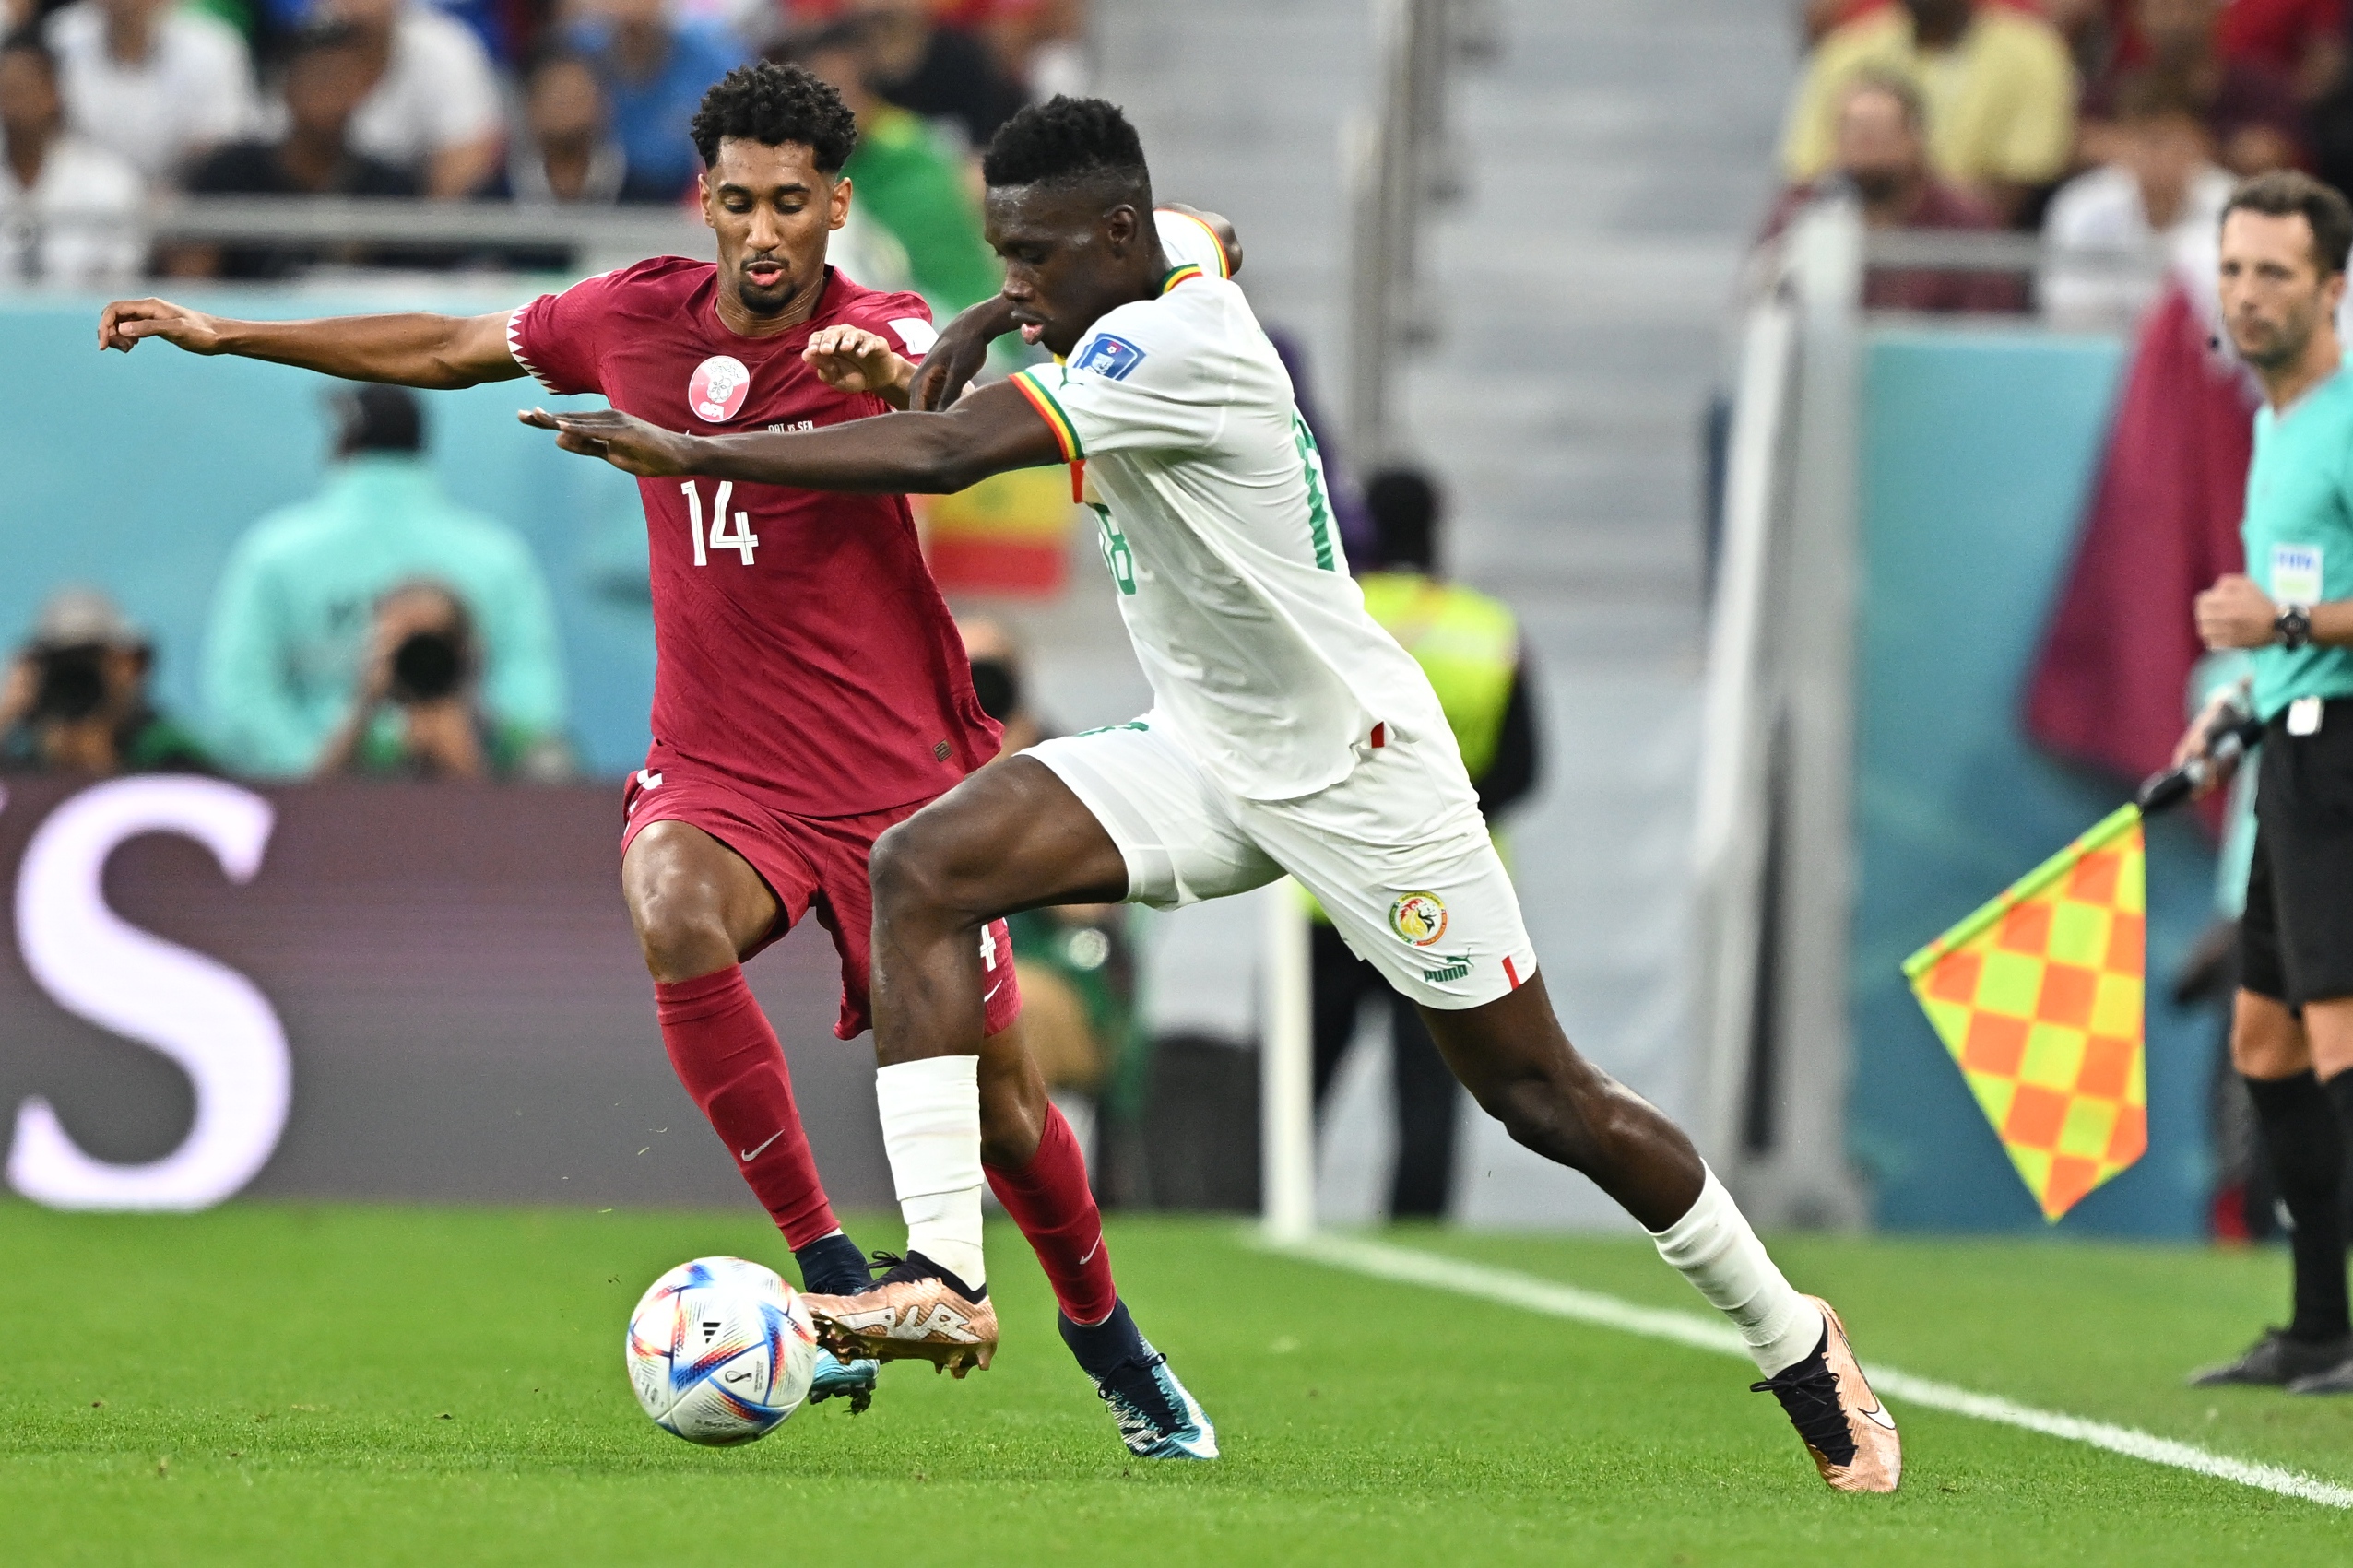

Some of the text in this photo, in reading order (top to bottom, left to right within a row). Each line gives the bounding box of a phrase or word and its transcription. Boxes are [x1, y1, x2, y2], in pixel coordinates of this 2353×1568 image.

[680, 479, 759, 567] 14
[0, 772, 293, 1214] S
[1424, 964, 1468, 983] PUMA
